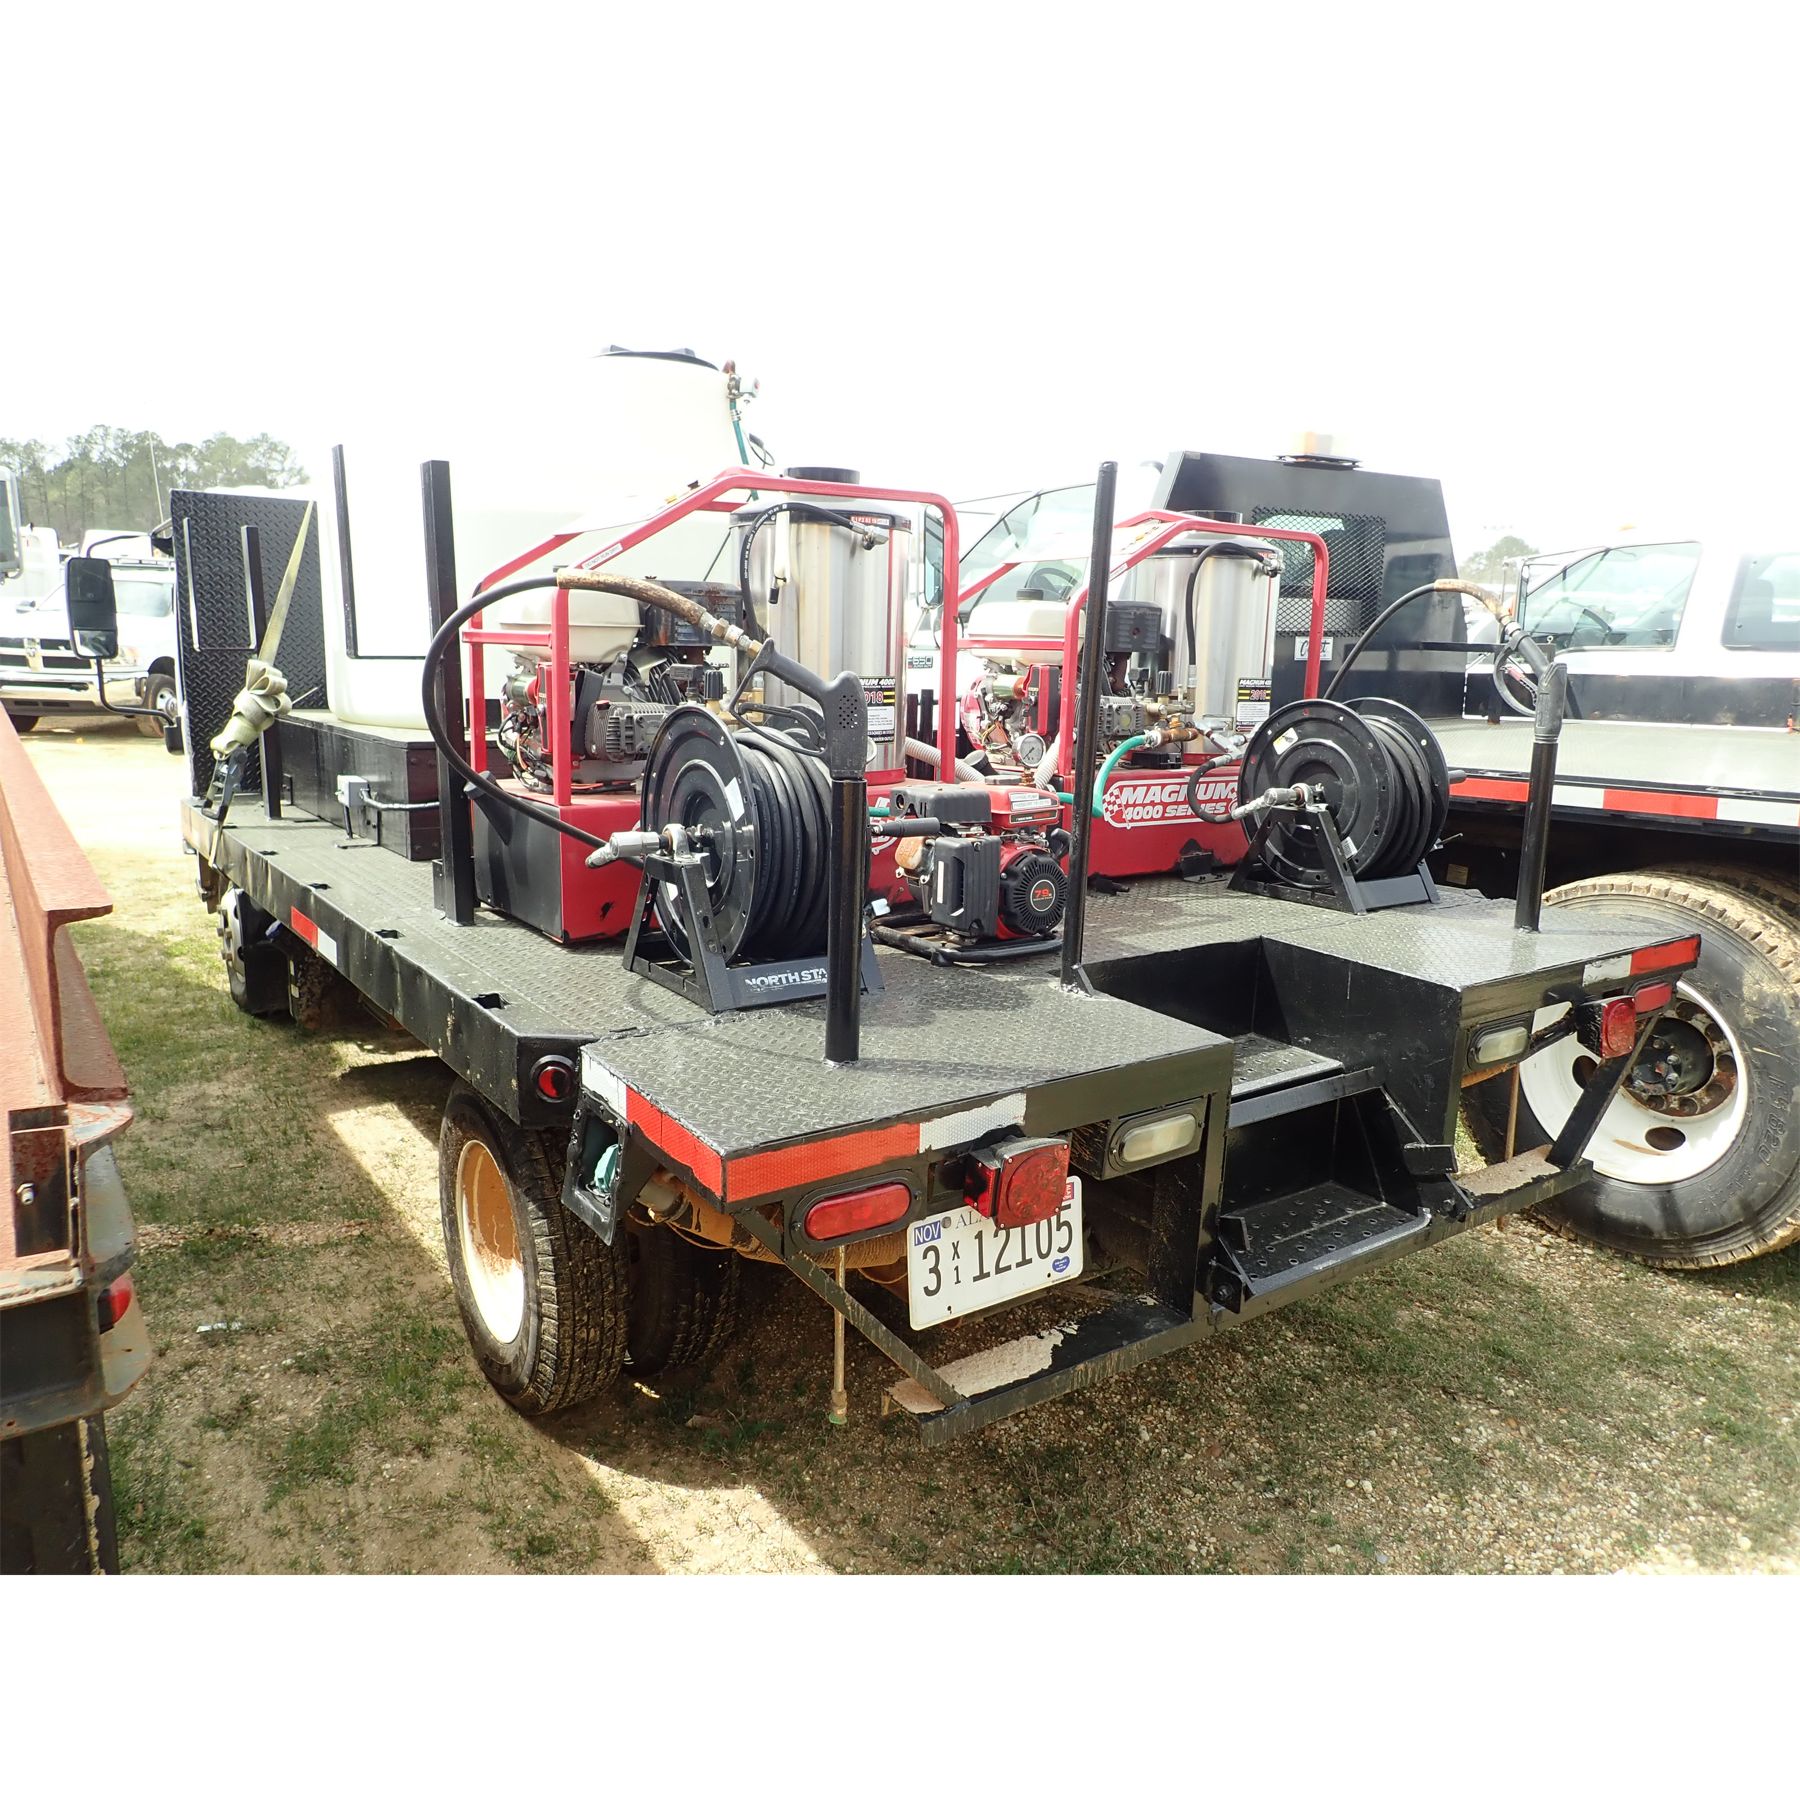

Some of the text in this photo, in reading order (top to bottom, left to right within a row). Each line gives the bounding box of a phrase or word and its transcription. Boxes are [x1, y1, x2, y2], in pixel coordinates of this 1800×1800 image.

[1122, 805, 1163, 820] 4000
[915, 1222, 940, 1246] NOV
[922, 1245, 942, 1297] 3
[972, 1204, 1073, 1283] 12105
